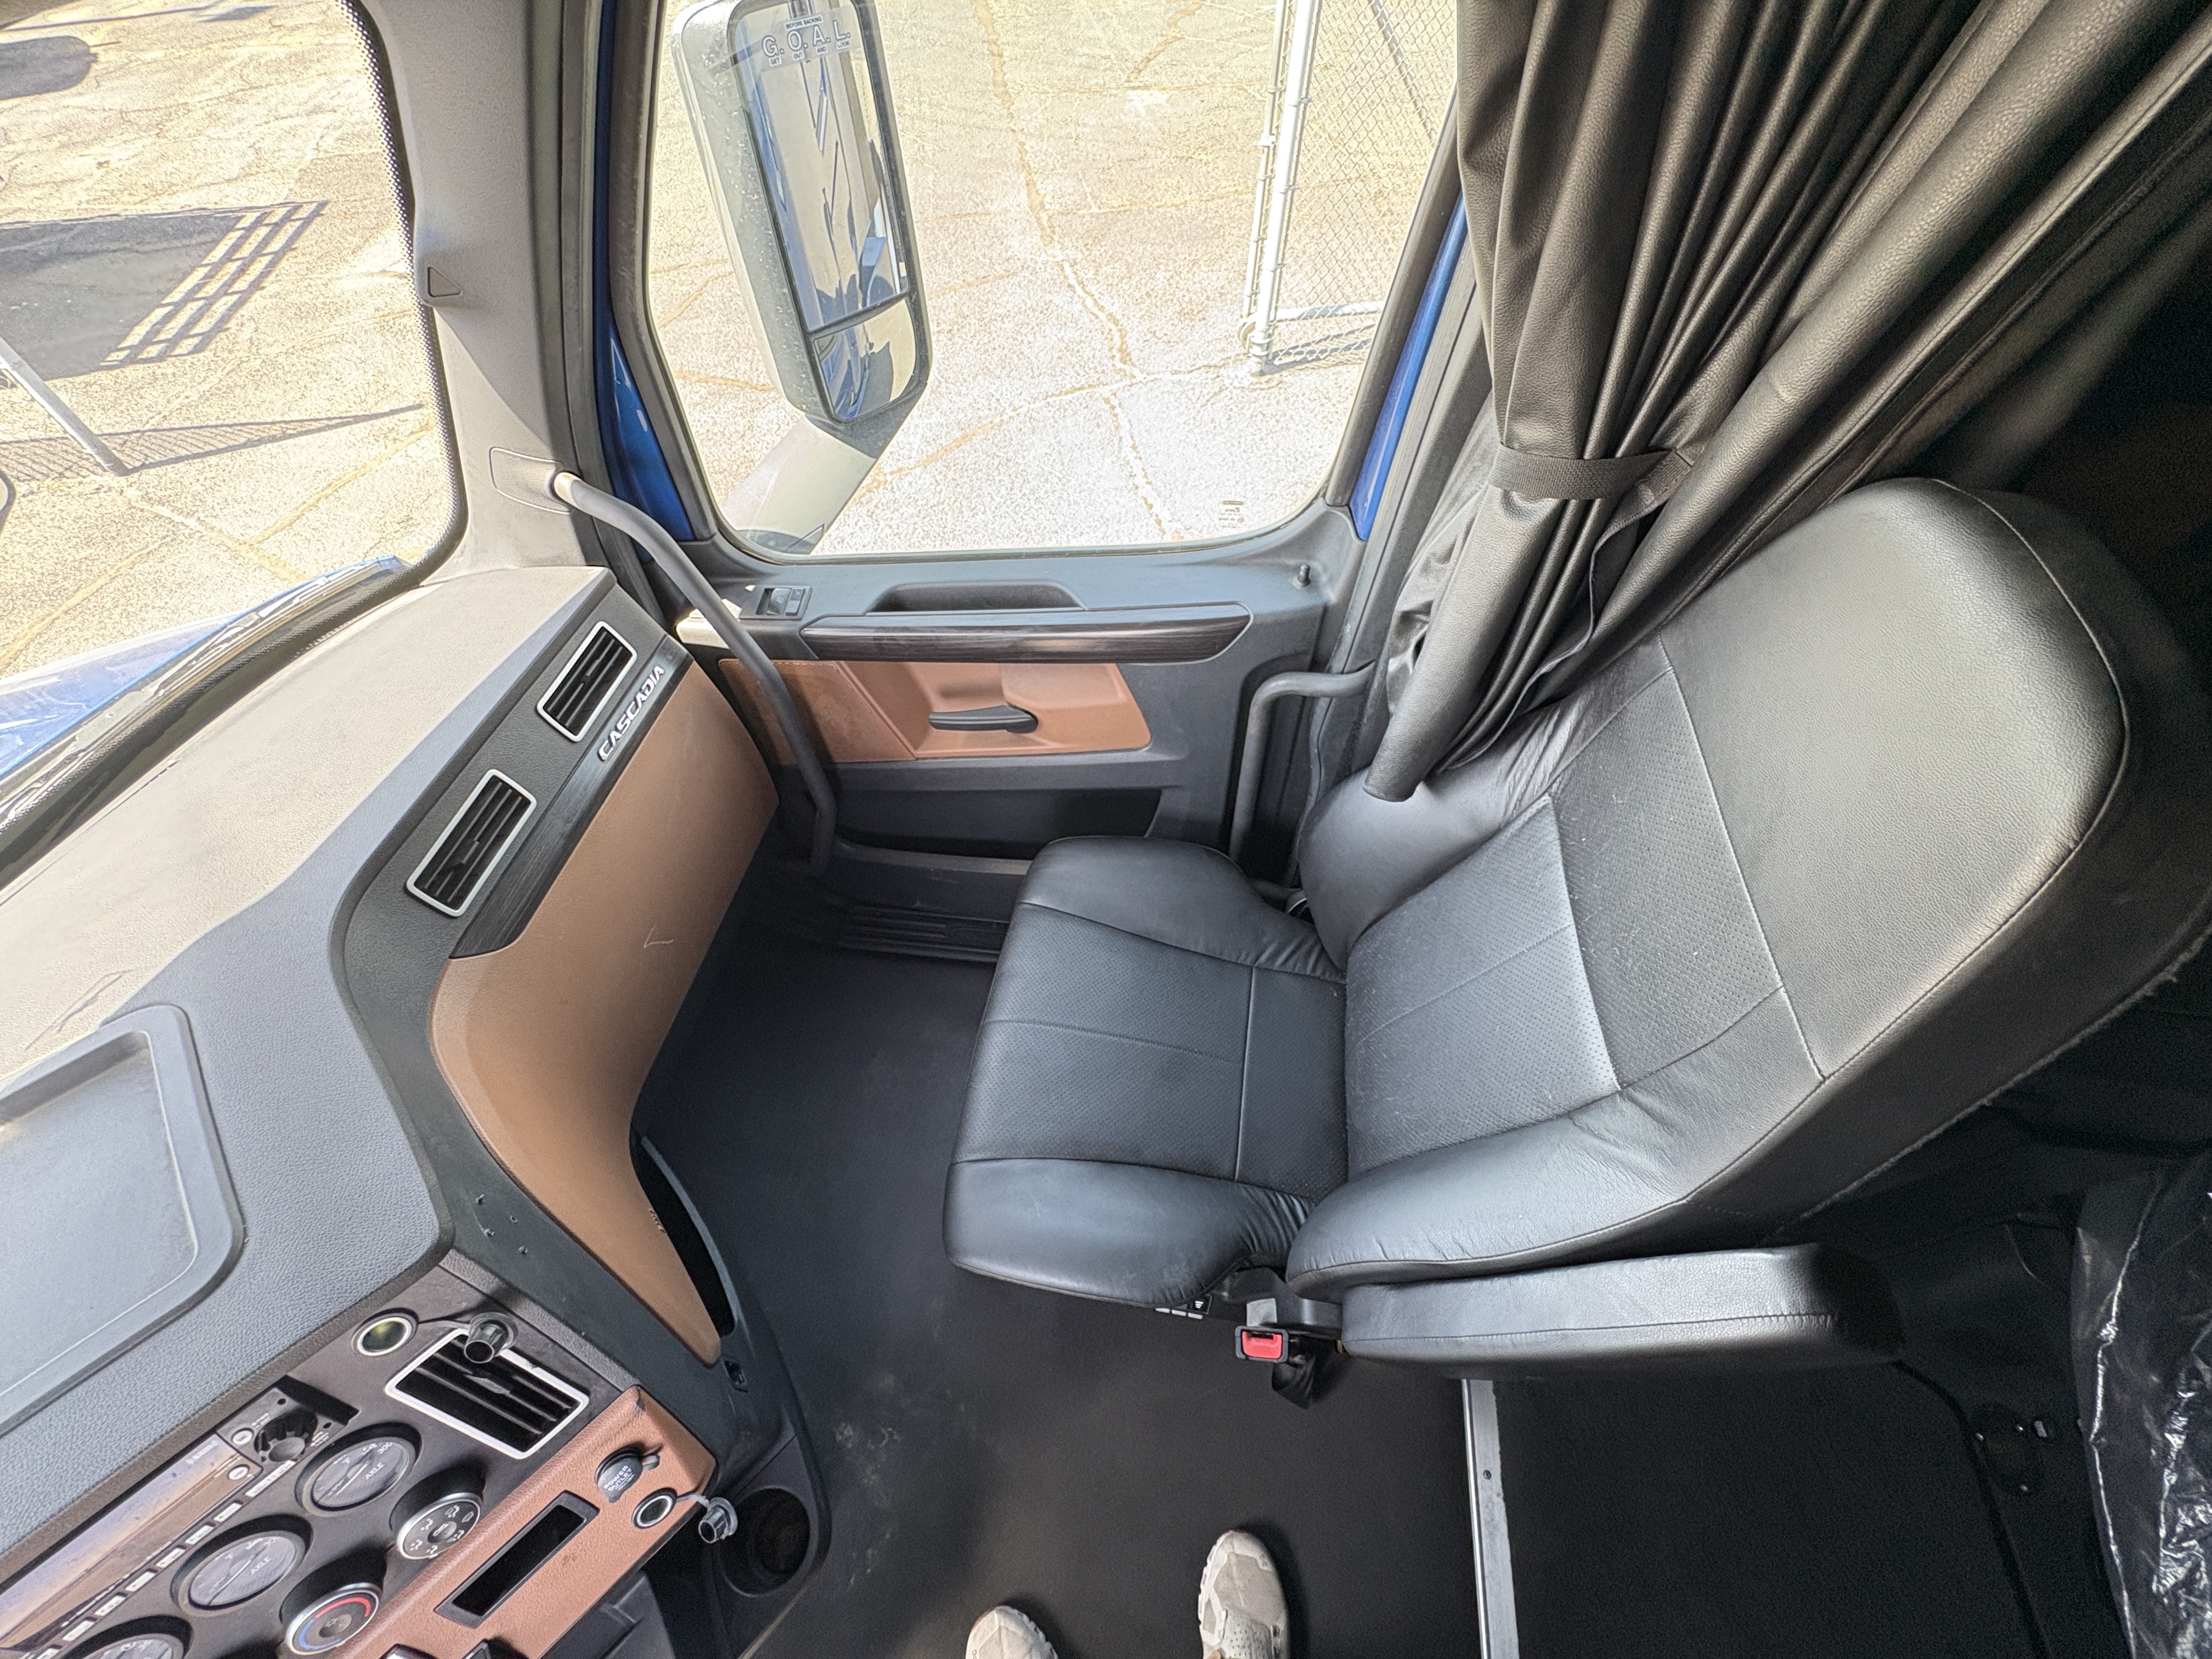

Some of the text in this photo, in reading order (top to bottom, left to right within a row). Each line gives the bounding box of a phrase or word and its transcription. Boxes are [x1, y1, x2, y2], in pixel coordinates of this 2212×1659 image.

[786, 16, 822, 29] BEFORE BACKING
[598, 665, 665, 761] CASCADIA
[366, 1462, 385, 1480] AXLE
[603, 1465, 629, 1489] POWER
[607, 1467, 633, 1492] OUTLET
